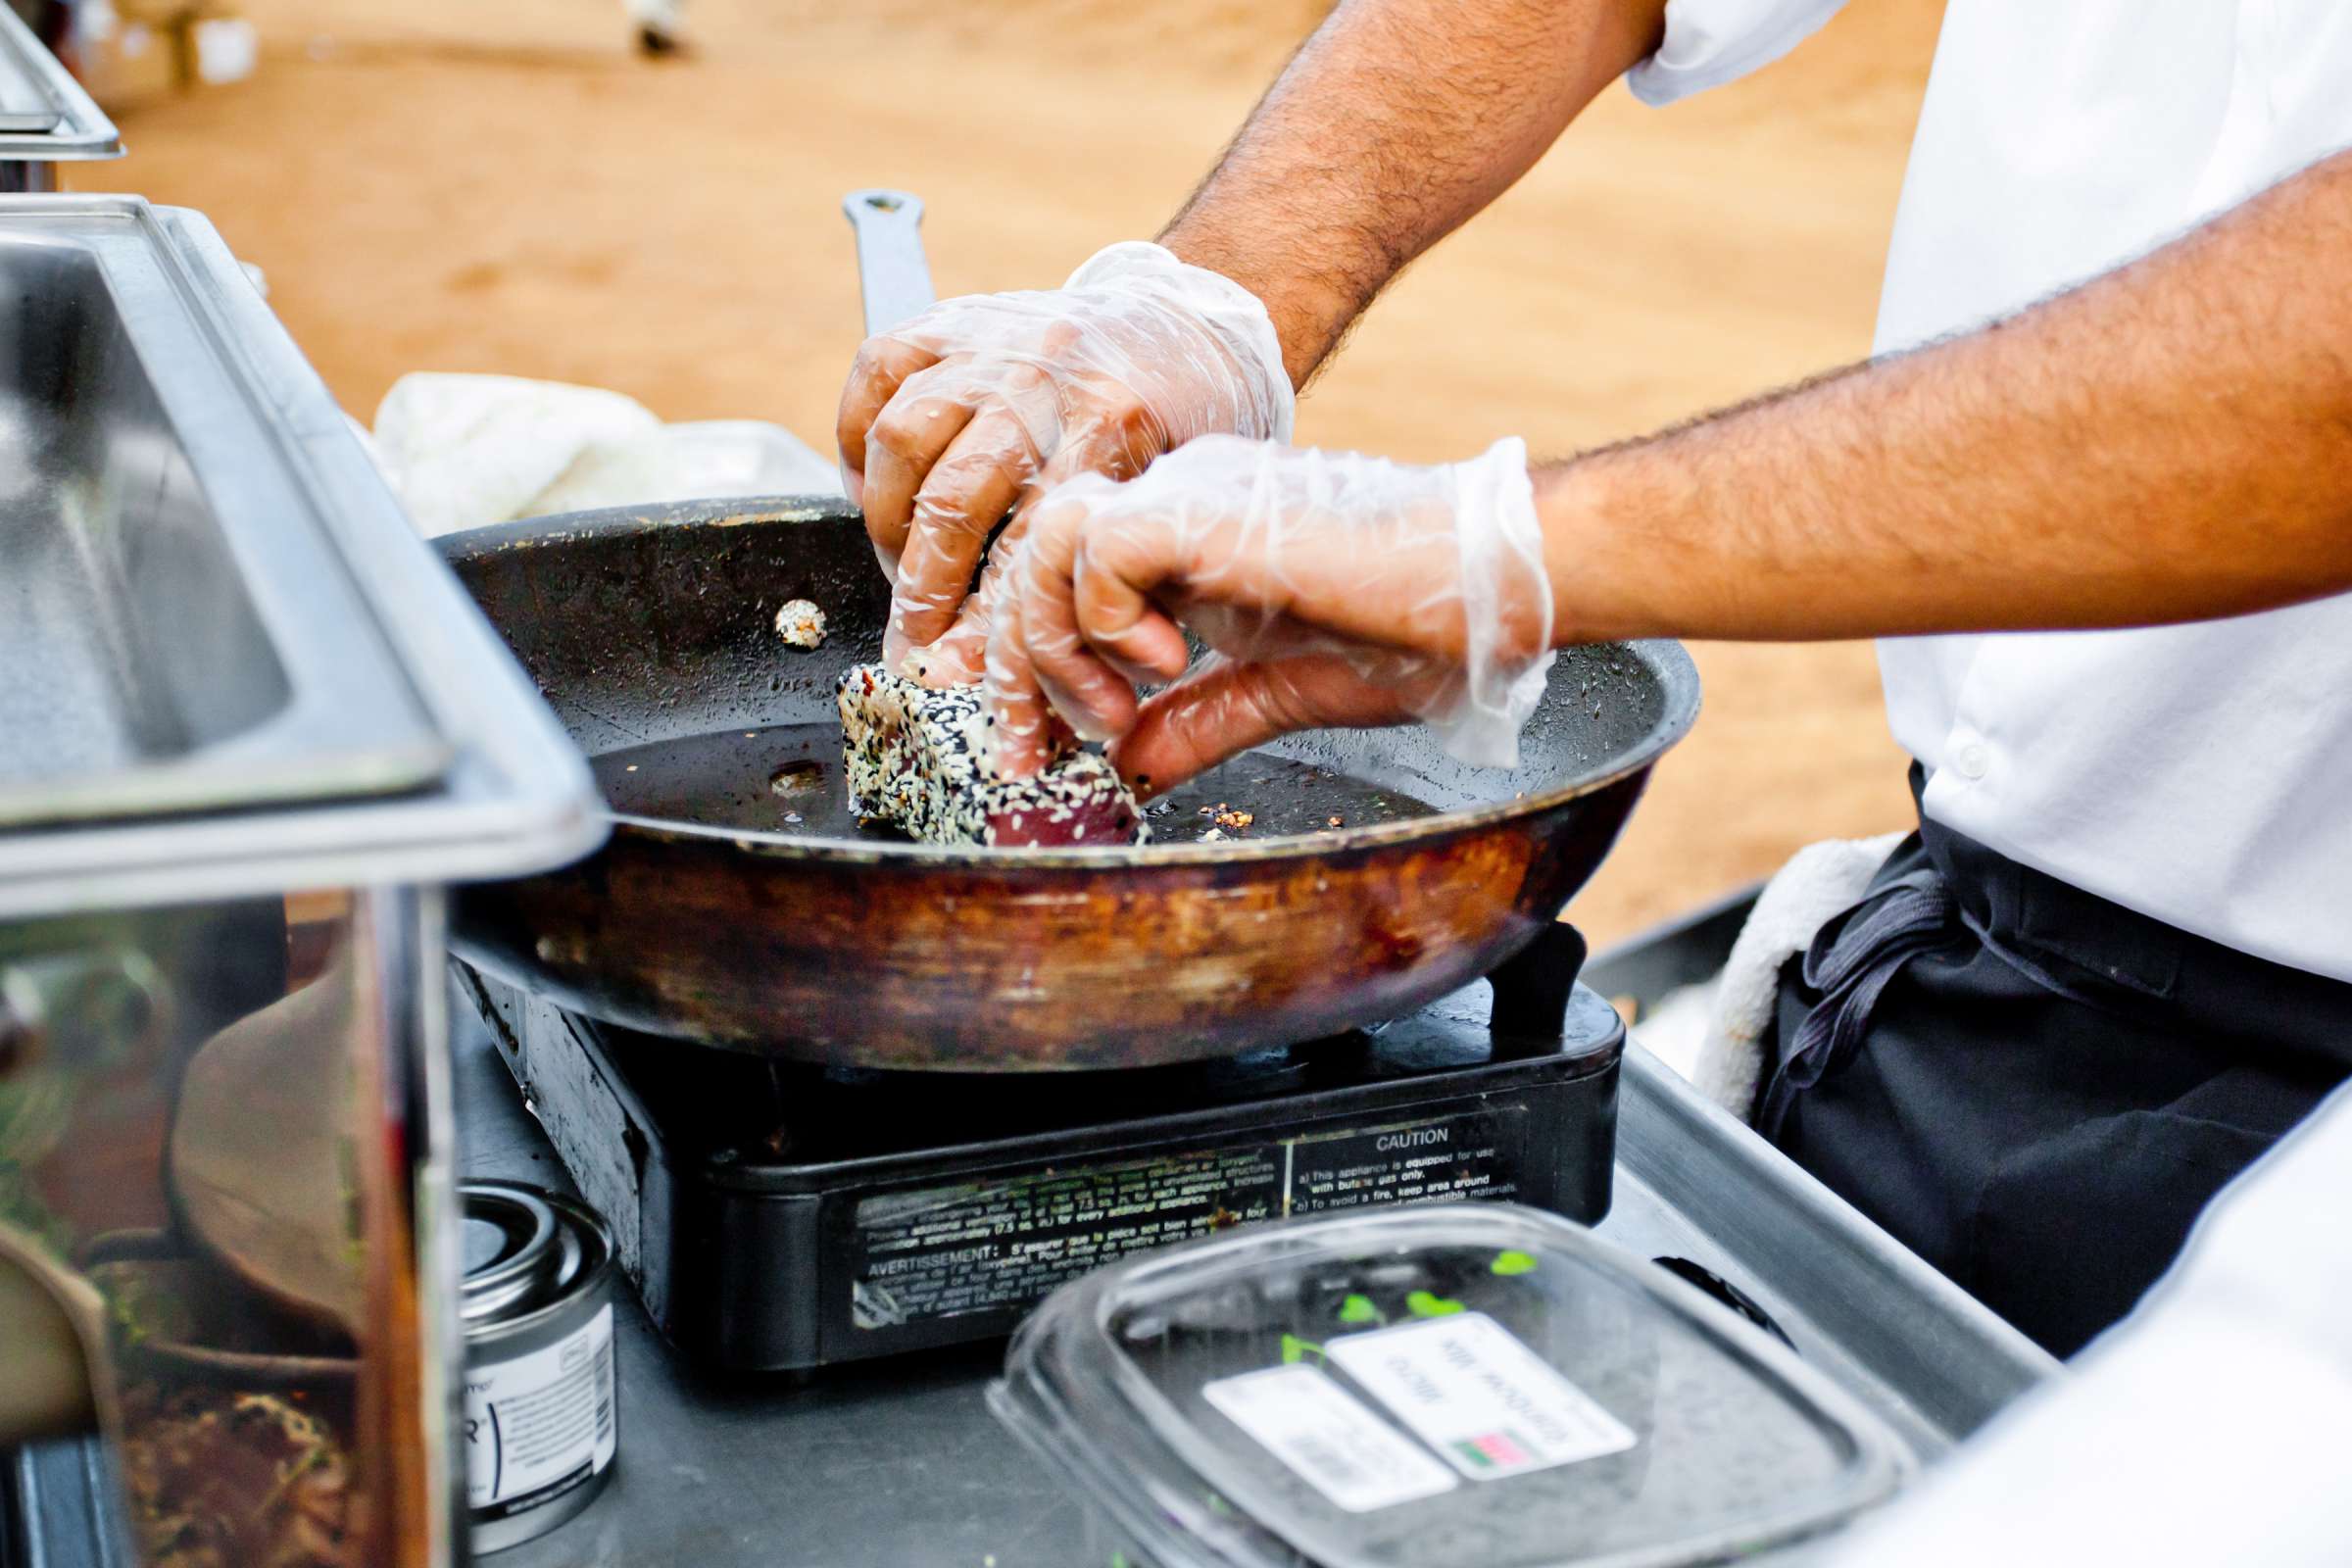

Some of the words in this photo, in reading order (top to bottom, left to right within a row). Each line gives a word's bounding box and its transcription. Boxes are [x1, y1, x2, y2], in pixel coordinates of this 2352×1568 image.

[1376, 1128, 1448, 1152] CAUTION
[1313, 1170, 1334, 1182] This
[1338, 1163, 1388, 1178] appliance
[1393, 1160, 1401, 1171] is
[1405, 1153, 1453, 1171] equipped
[1457, 1151, 1471, 1161] for
[1311, 1200, 1325, 1209] To
[1329, 1194, 1357, 1207] avoid
[1362, 1194, 1369, 1203] a
[1373, 1189, 1393, 1201] fire,
[1397, 1185, 1424, 1198] keep
[1427, 1181, 1449, 1194] area
[1454, 1174, 1490, 1188] around
[1312, 1182, 1334, 1195] with
[1401, 1168, 1426, 1182] only.
[1076, 1209, 1104, 1223] every
[1164, 1218, 1187, 1232] bien
[1247, 1206, 1267, 1219] four
